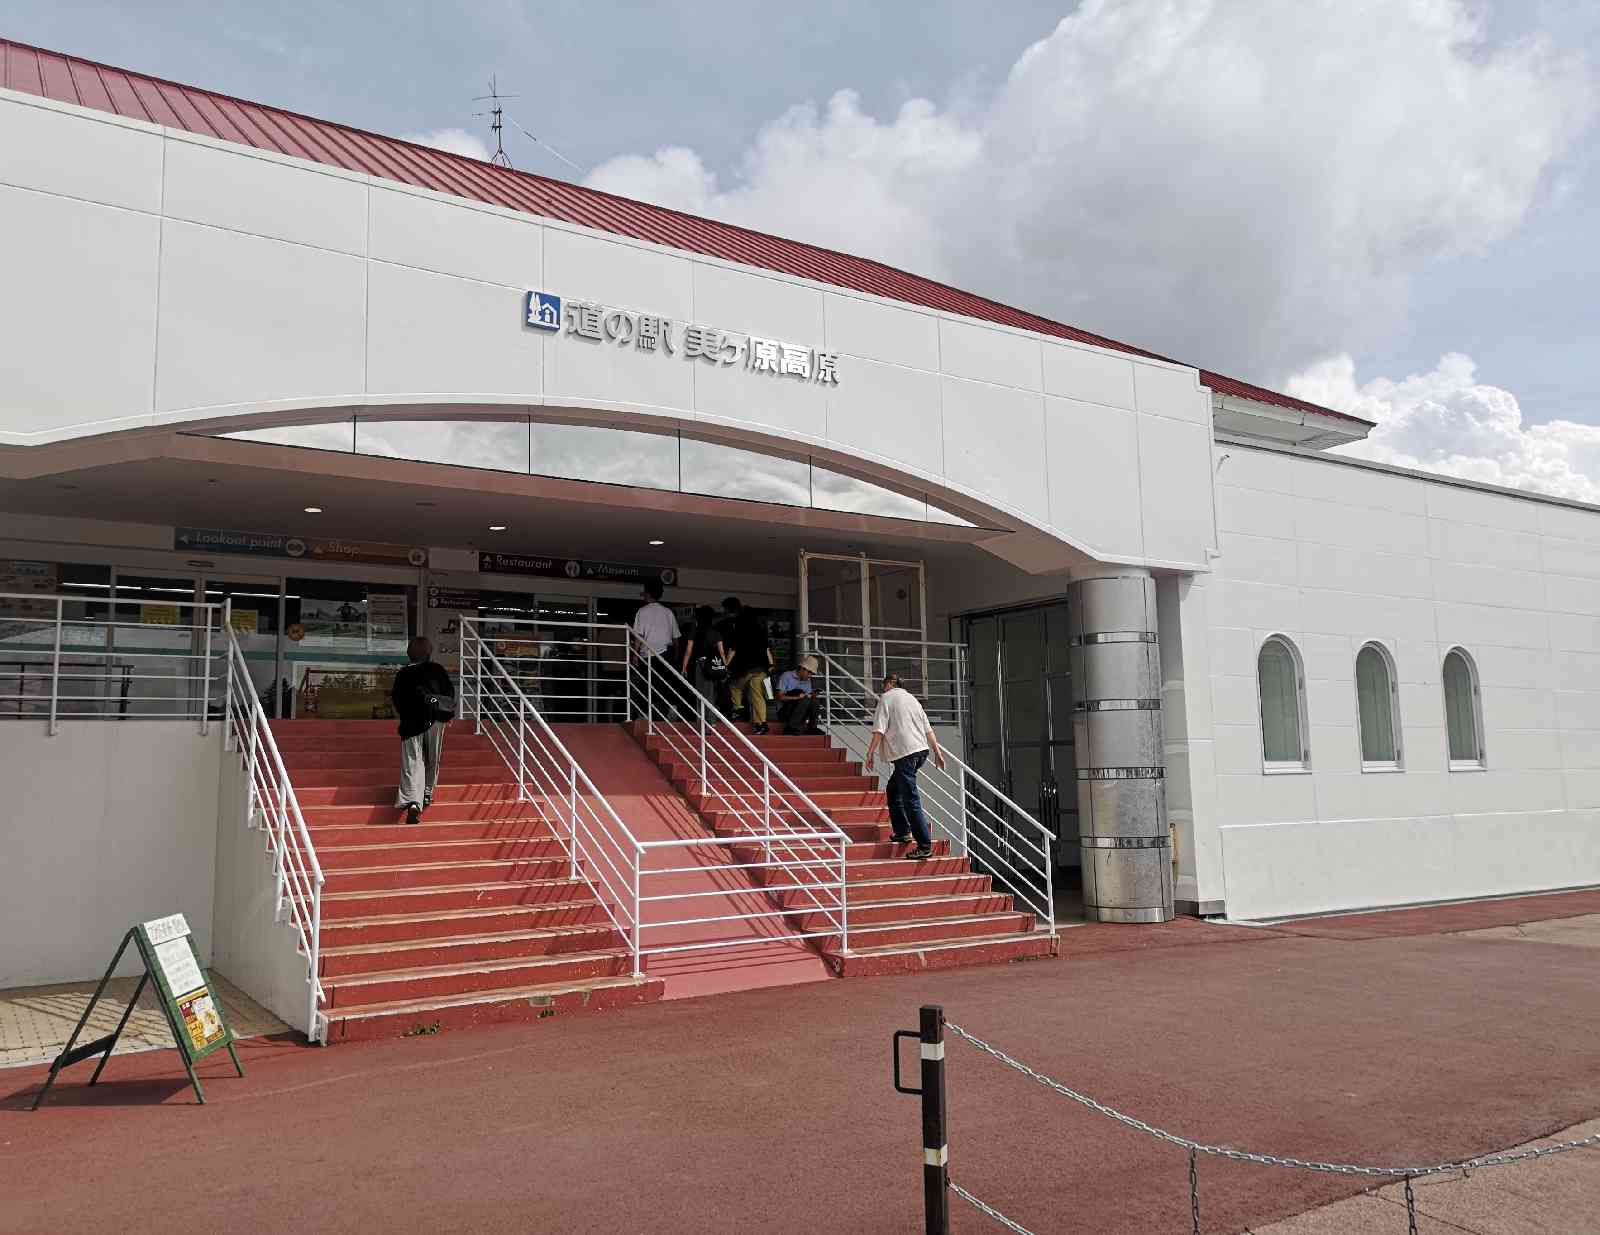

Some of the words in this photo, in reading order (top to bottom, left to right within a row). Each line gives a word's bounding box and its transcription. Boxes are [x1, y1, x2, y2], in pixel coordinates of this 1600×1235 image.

[566, 301, 675, 355] 道の駅
[328, 541, 360, 556] Shop
[495, 554, 553, 569] Restaurant
